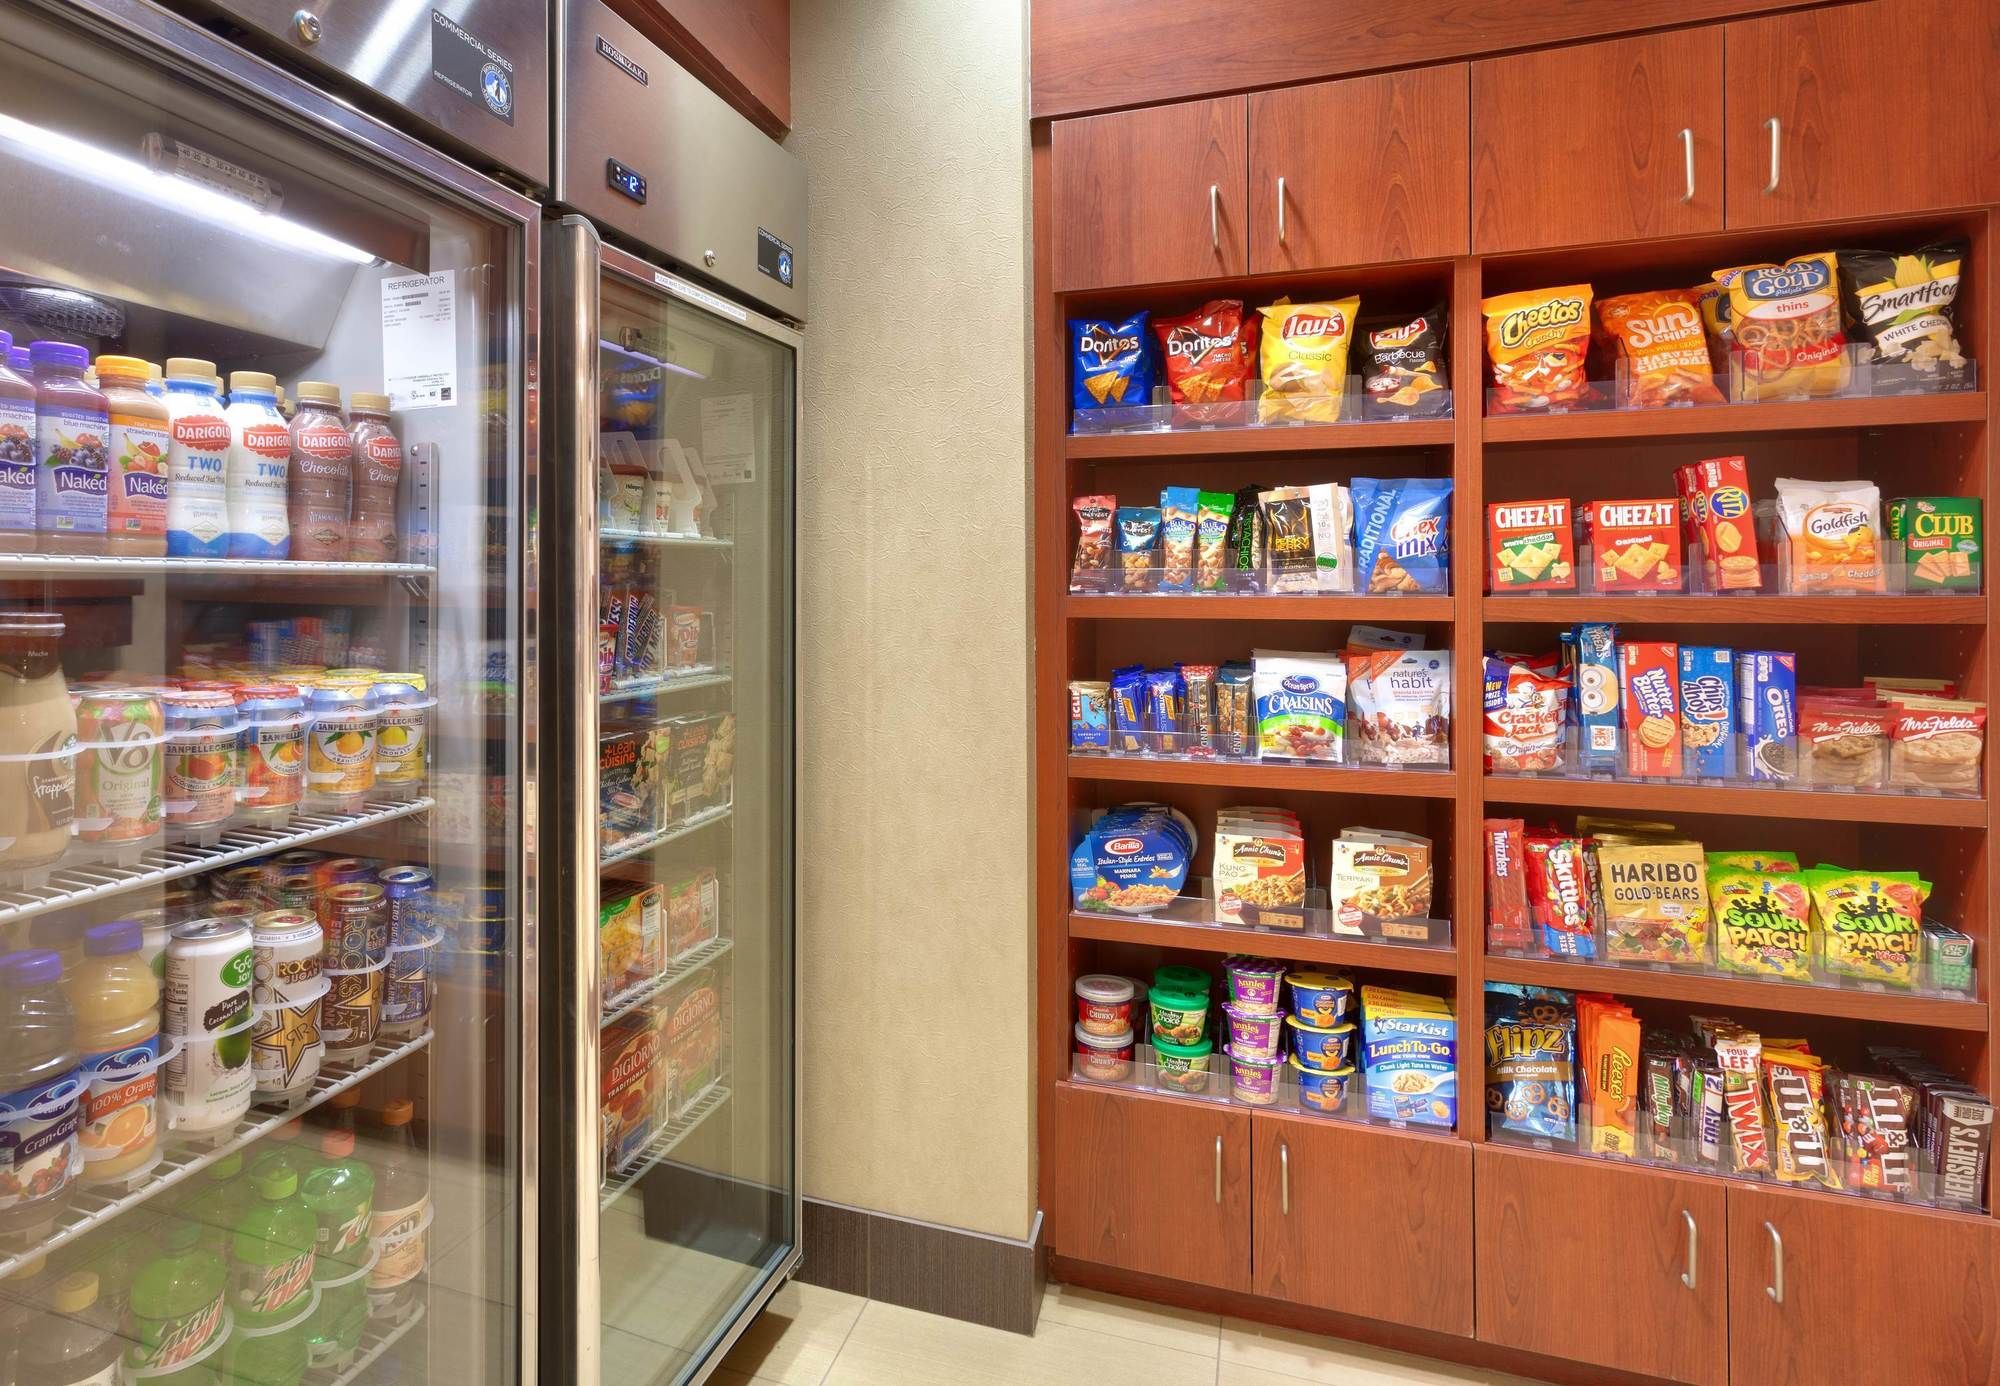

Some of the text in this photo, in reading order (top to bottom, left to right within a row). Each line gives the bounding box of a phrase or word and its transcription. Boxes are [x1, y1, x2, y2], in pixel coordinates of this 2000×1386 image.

[433, 12, 514, 73] COMMERCIAL SERIES
[601, 41, 648, 82] HOSHIZAKI
[388, 276, 446, 291] REFRIGERATOR
[1752, 270, 1824, 297] GOLD
[1776, 300, 1809, 313] thins
[1287, 313, 1343, 338] Lay's
[1501, 300, 1582, 347] Cheetos
[1627, 311, 1698, 348] Sun
[1523, 327, 1566, 349] Crunchy
[1653, 326, 1700, 343] CHIPS
[1884, 323, 1918, 341] WHITE
[1080, 336, 1139, 354] Doritos
[1167, 333, 1234, 357] Doritos
[1796, 343, 1839, 362] Original
[1288, 350, 1332, 362] Classic
[1374, 350, 1426, 364] Barbecue
[126, 427, 157, 438] strawberry
[177, 426, 231, 439] DARIGOLD
[187, 456, 223, 473] TWO
[258, 463, 286, 479] TWO
[0, 469, 35, 485] aked
[60, 471, 107, 491] Naked
[175, 472, 204, 482] Reduced
[1716, 487, 1743, 517] RITZ
[1811, 511, 1869, 534] Goldfish
[1914, 512, 1974, 537] CLUB
[1275, 536, 1310, 545] PERKY
[1523, 532, 1554, 545] cheddar
[1912, 539, 1945, 548] ORIGINAL
[1275, 543, 1310, 551] JERKY
[1392, 668, 1428, 678] nature's
[1390, 677, 1434, 689] habit
[1485, 681, 1503, 691] NEW
[1647, 668, 1674, 713] Nutter
[1485, 691, 1501, 701] PRIZE
[1633, 674, 1663, 719] Butter
[1699, 676, 1723, 712] Chips
[1268, 694, 1334, 715] CRAISINS
[1766, 688, 1787, 738] OREO
[1504, 724, 1545, 738] Jack
[1930, 715, 1977, 735] Fields
[1200, 724, 1209, 748] KIND
[1234, 731, 1242, 754] KIND
[98, 721, 152, 768] V8
[103, 778, 150, 792] Original
[1114, 841, 1140, 851] Barilla
[1234, 844, 1282, 857] Annie Chun's
[1494, 830, 1509, 877] Twizzlers
[1356, 852, 1407, 866] Annie Chun's
[1219, 864, 1247, 872] KUNG
[1219, 870, 1239, 878] PAO
[1611, 863, 1698, 883] HARIBO
[1336, 872, 1374, 883] TERIYAKI
[1548, 849, 1580, 926] Skittles
[1614, 886, 1700, 901] GOLD-BEARS
[1727, 909, 1800, 932] SOUR
[1836, 912, 1915, 933] SOUR
[1558, 935, 1569, 954] SIZE
[1730, 927, 1808, 952] PATCH
[1840, 930, 1917, 953] PATCH
[1761, 945, 1795, 958] Kids
[1874, 949, 1907, 963] Kids
[1238, 979, 1266, 989] Annie's
[222, 999, 238, 1011] Pure
[1157, 1014, 1182, 1026] Choice
[1159, 1010, 1181, 1018] Healthy
[1232, 1022, 1260, 1033] Annie's
[1387, 1018, 1449, 1037] StarKist
[1370, 1042, 1412, 1058] Lunch
[1485, 1025, 1565, 1066] Flipz
[1726, 1048, 1749, 1056] FOUR
[1164, 1061, 1190, 1073] Choice
[1397, 1063, 1411, 1071] Light
[1515, 1064, 1558, 1074] Chocolate
[1720, 1054, 1761, 1070] LEFT
[1235, 1066, 1263, 1078] Annie's
[1610, 1046, 1632, 1102] Reese's
[1706, 1076, 1720, 1090] 2
[91, 1088, 121, 1112] 100%
[1652, 1073, 1674, 1127] Milky Way
[1725, 1081, 1769, 1169] TWIX
[1944, 1126, 1981, 1202] HERSHEY'S
